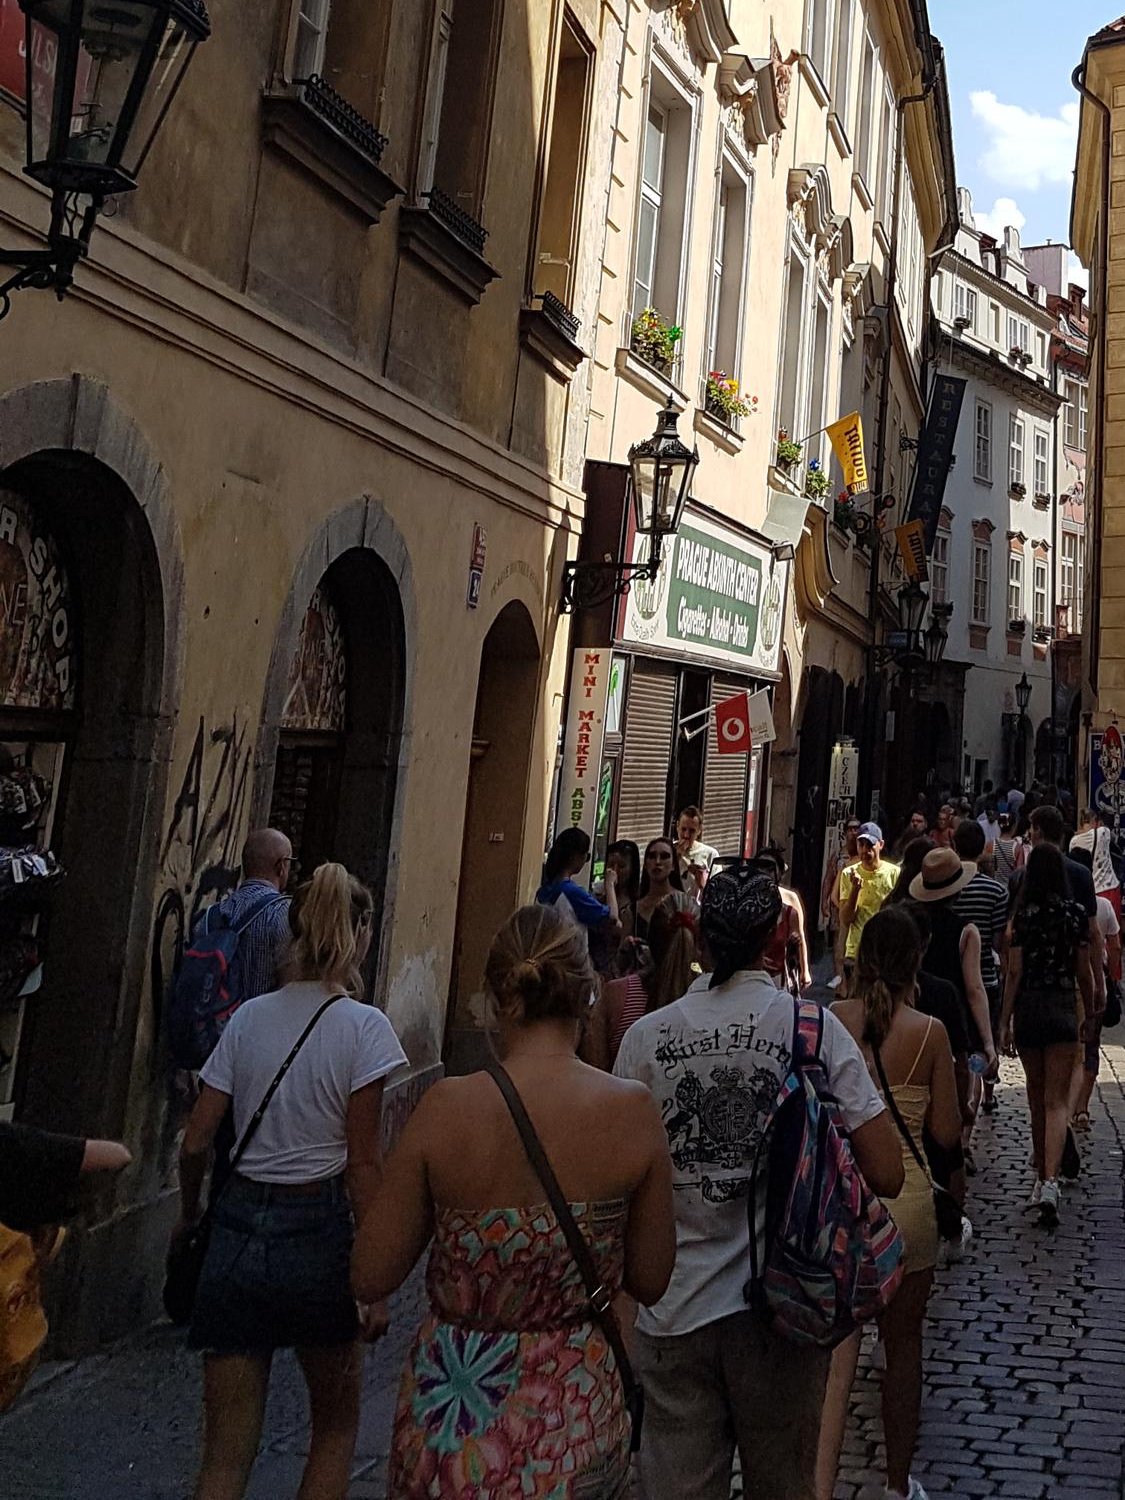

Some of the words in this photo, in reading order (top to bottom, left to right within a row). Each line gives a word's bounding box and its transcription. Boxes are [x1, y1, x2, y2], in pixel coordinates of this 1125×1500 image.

[676, 537, 710, 588] PRAGUE
[735, 562, 760, 607] CENTER
[584, 653, 600, 698] MINI
[575, 710, 595, 779] MARKET
[571, 787, 586, 828] ABS
